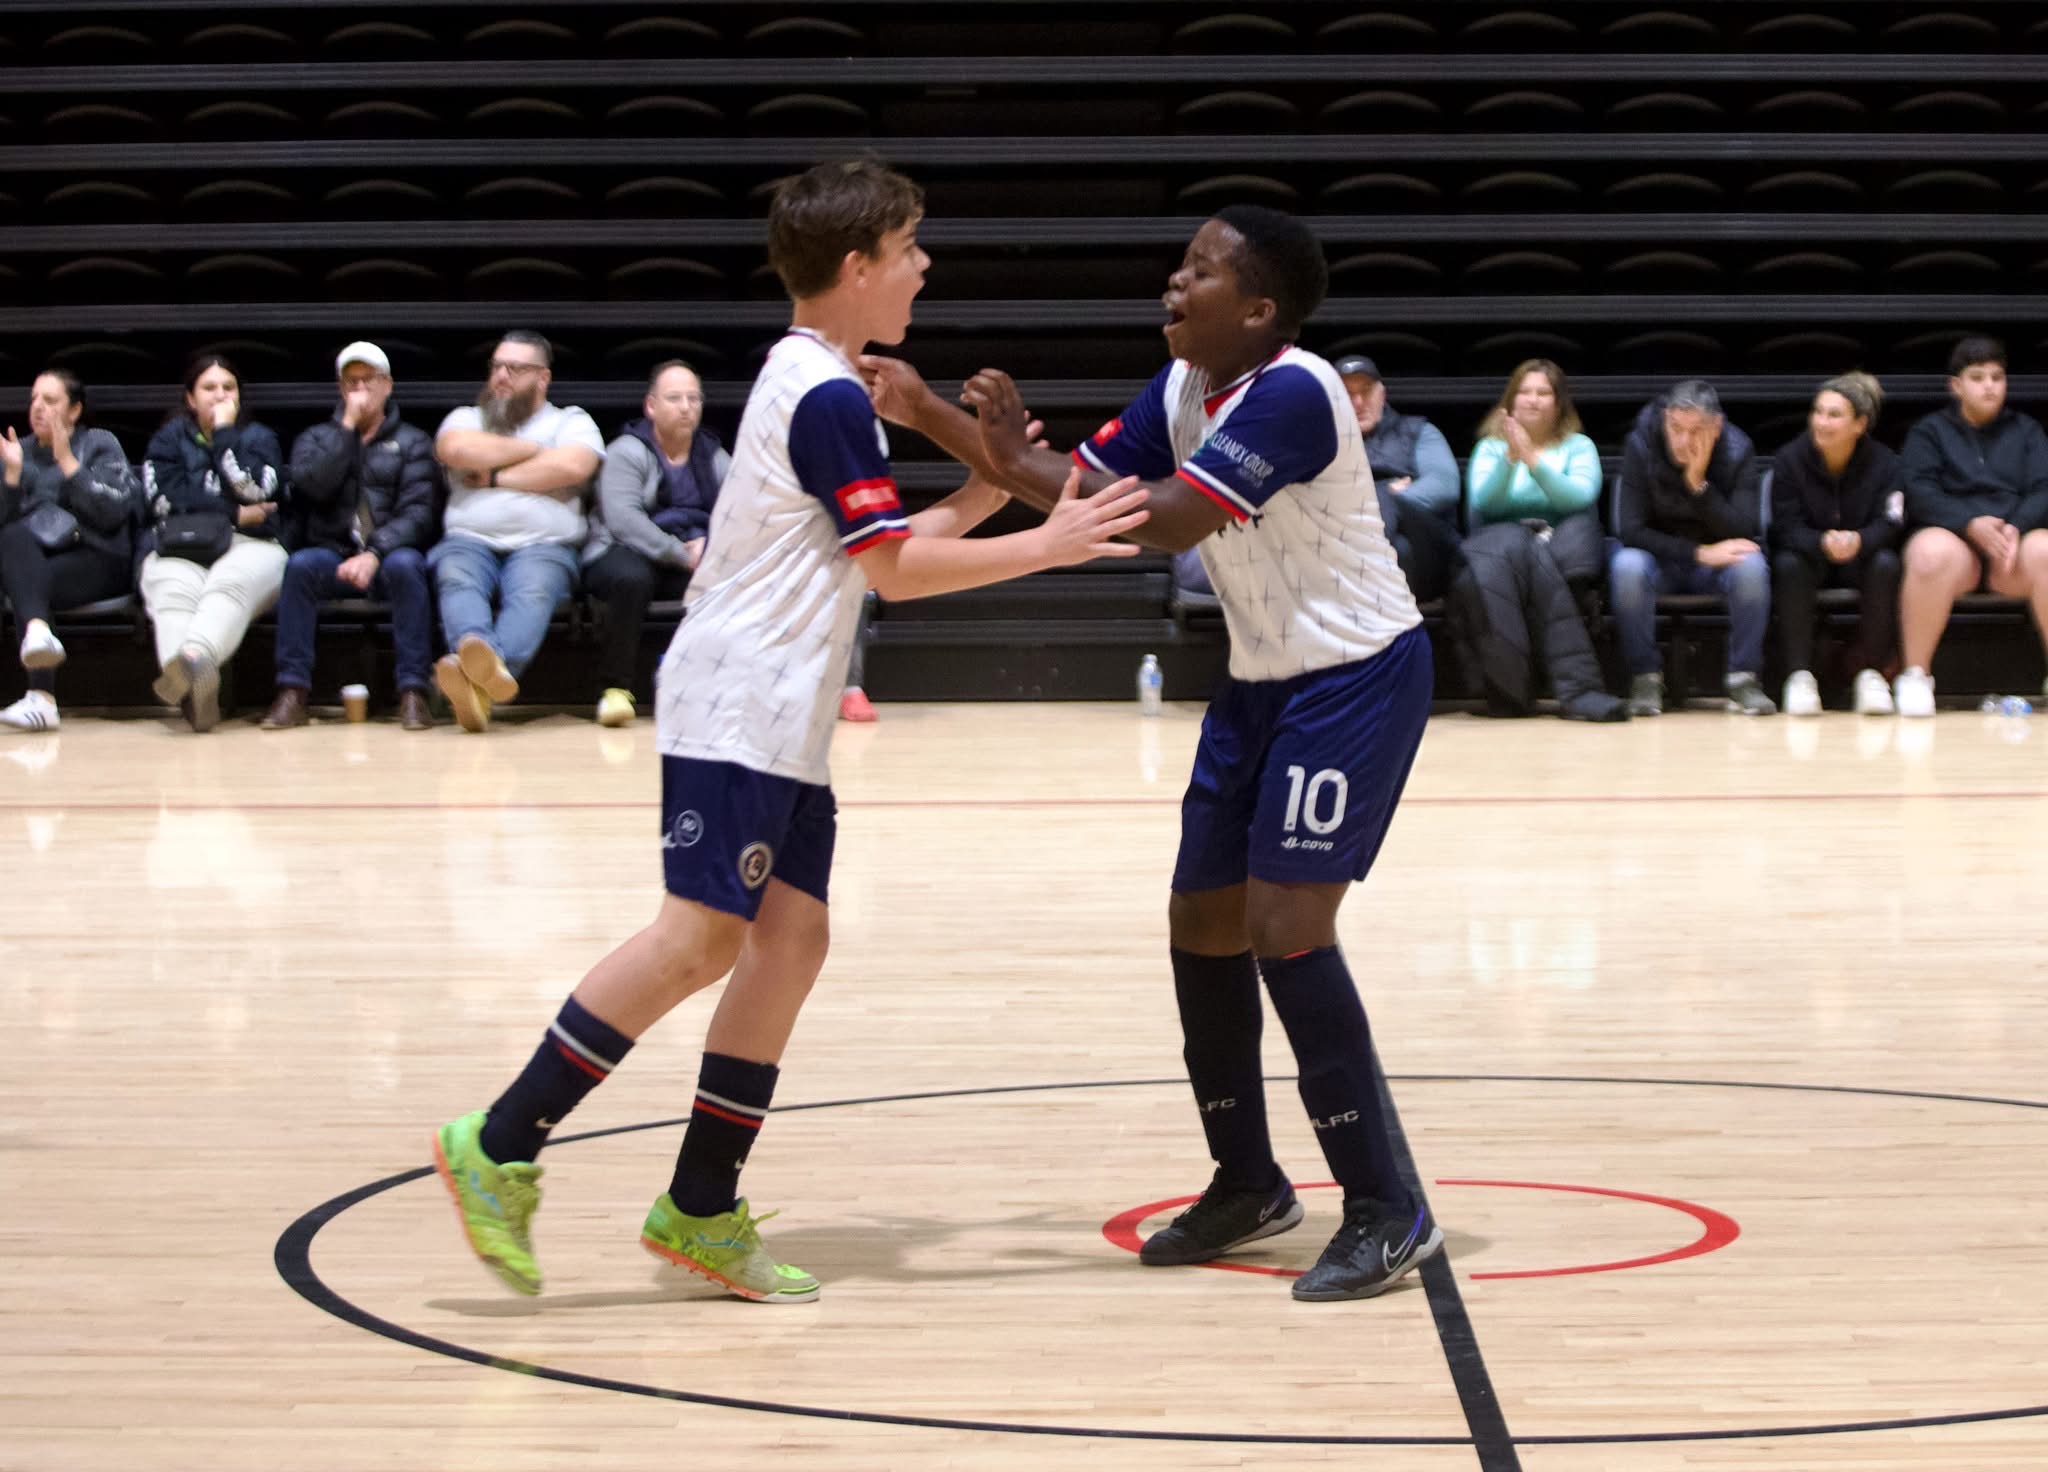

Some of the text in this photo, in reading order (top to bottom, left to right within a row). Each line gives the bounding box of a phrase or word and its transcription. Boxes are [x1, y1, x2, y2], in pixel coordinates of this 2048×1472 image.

[1244, 452, 1275, 479] GROUP
[1283, 765, 1348, 834] 10
[1199, 1098, 1237, 1112] FC
